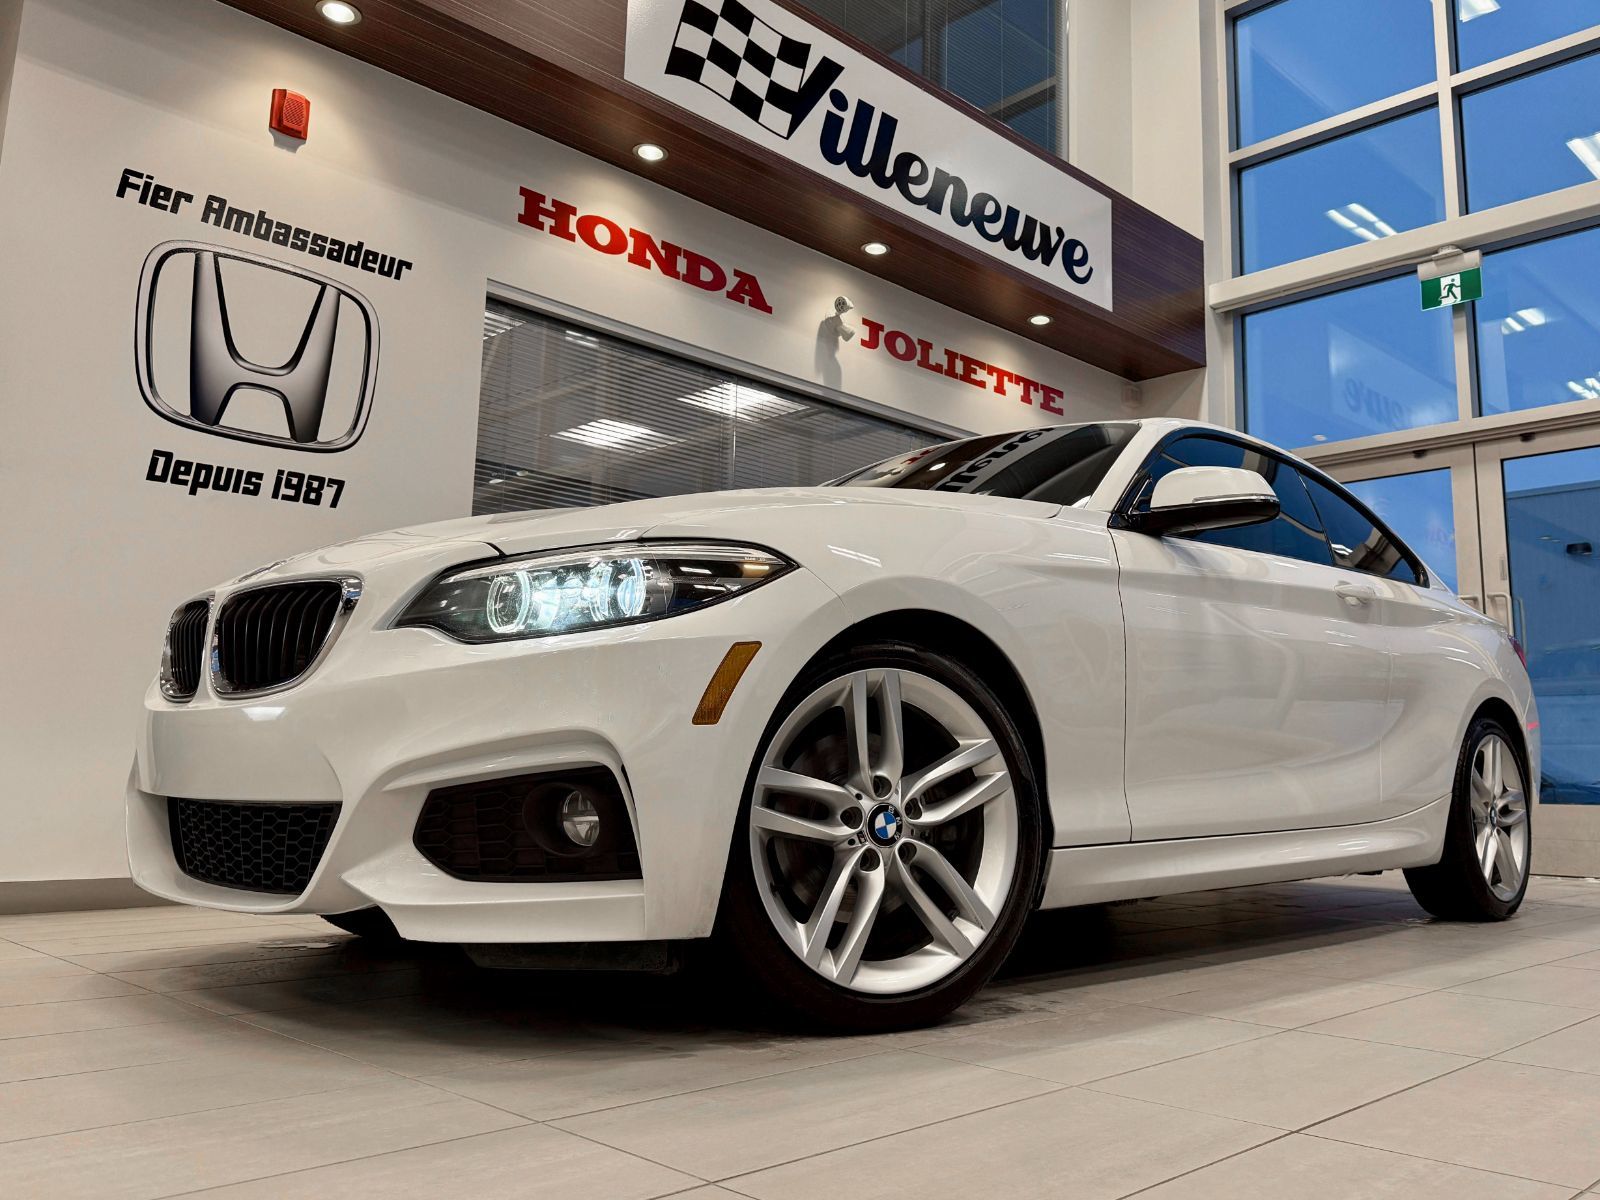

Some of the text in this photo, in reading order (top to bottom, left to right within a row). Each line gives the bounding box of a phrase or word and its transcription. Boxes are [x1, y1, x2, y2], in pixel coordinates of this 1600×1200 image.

[116, 168, 412, 280] Fier Ambassadeur
[786, 46, 1094, 285] Villeneuve
[517, 186, 1065, 416] HONDA JOLIETTE
[146, 449, 345, 509] Depuis 1987
